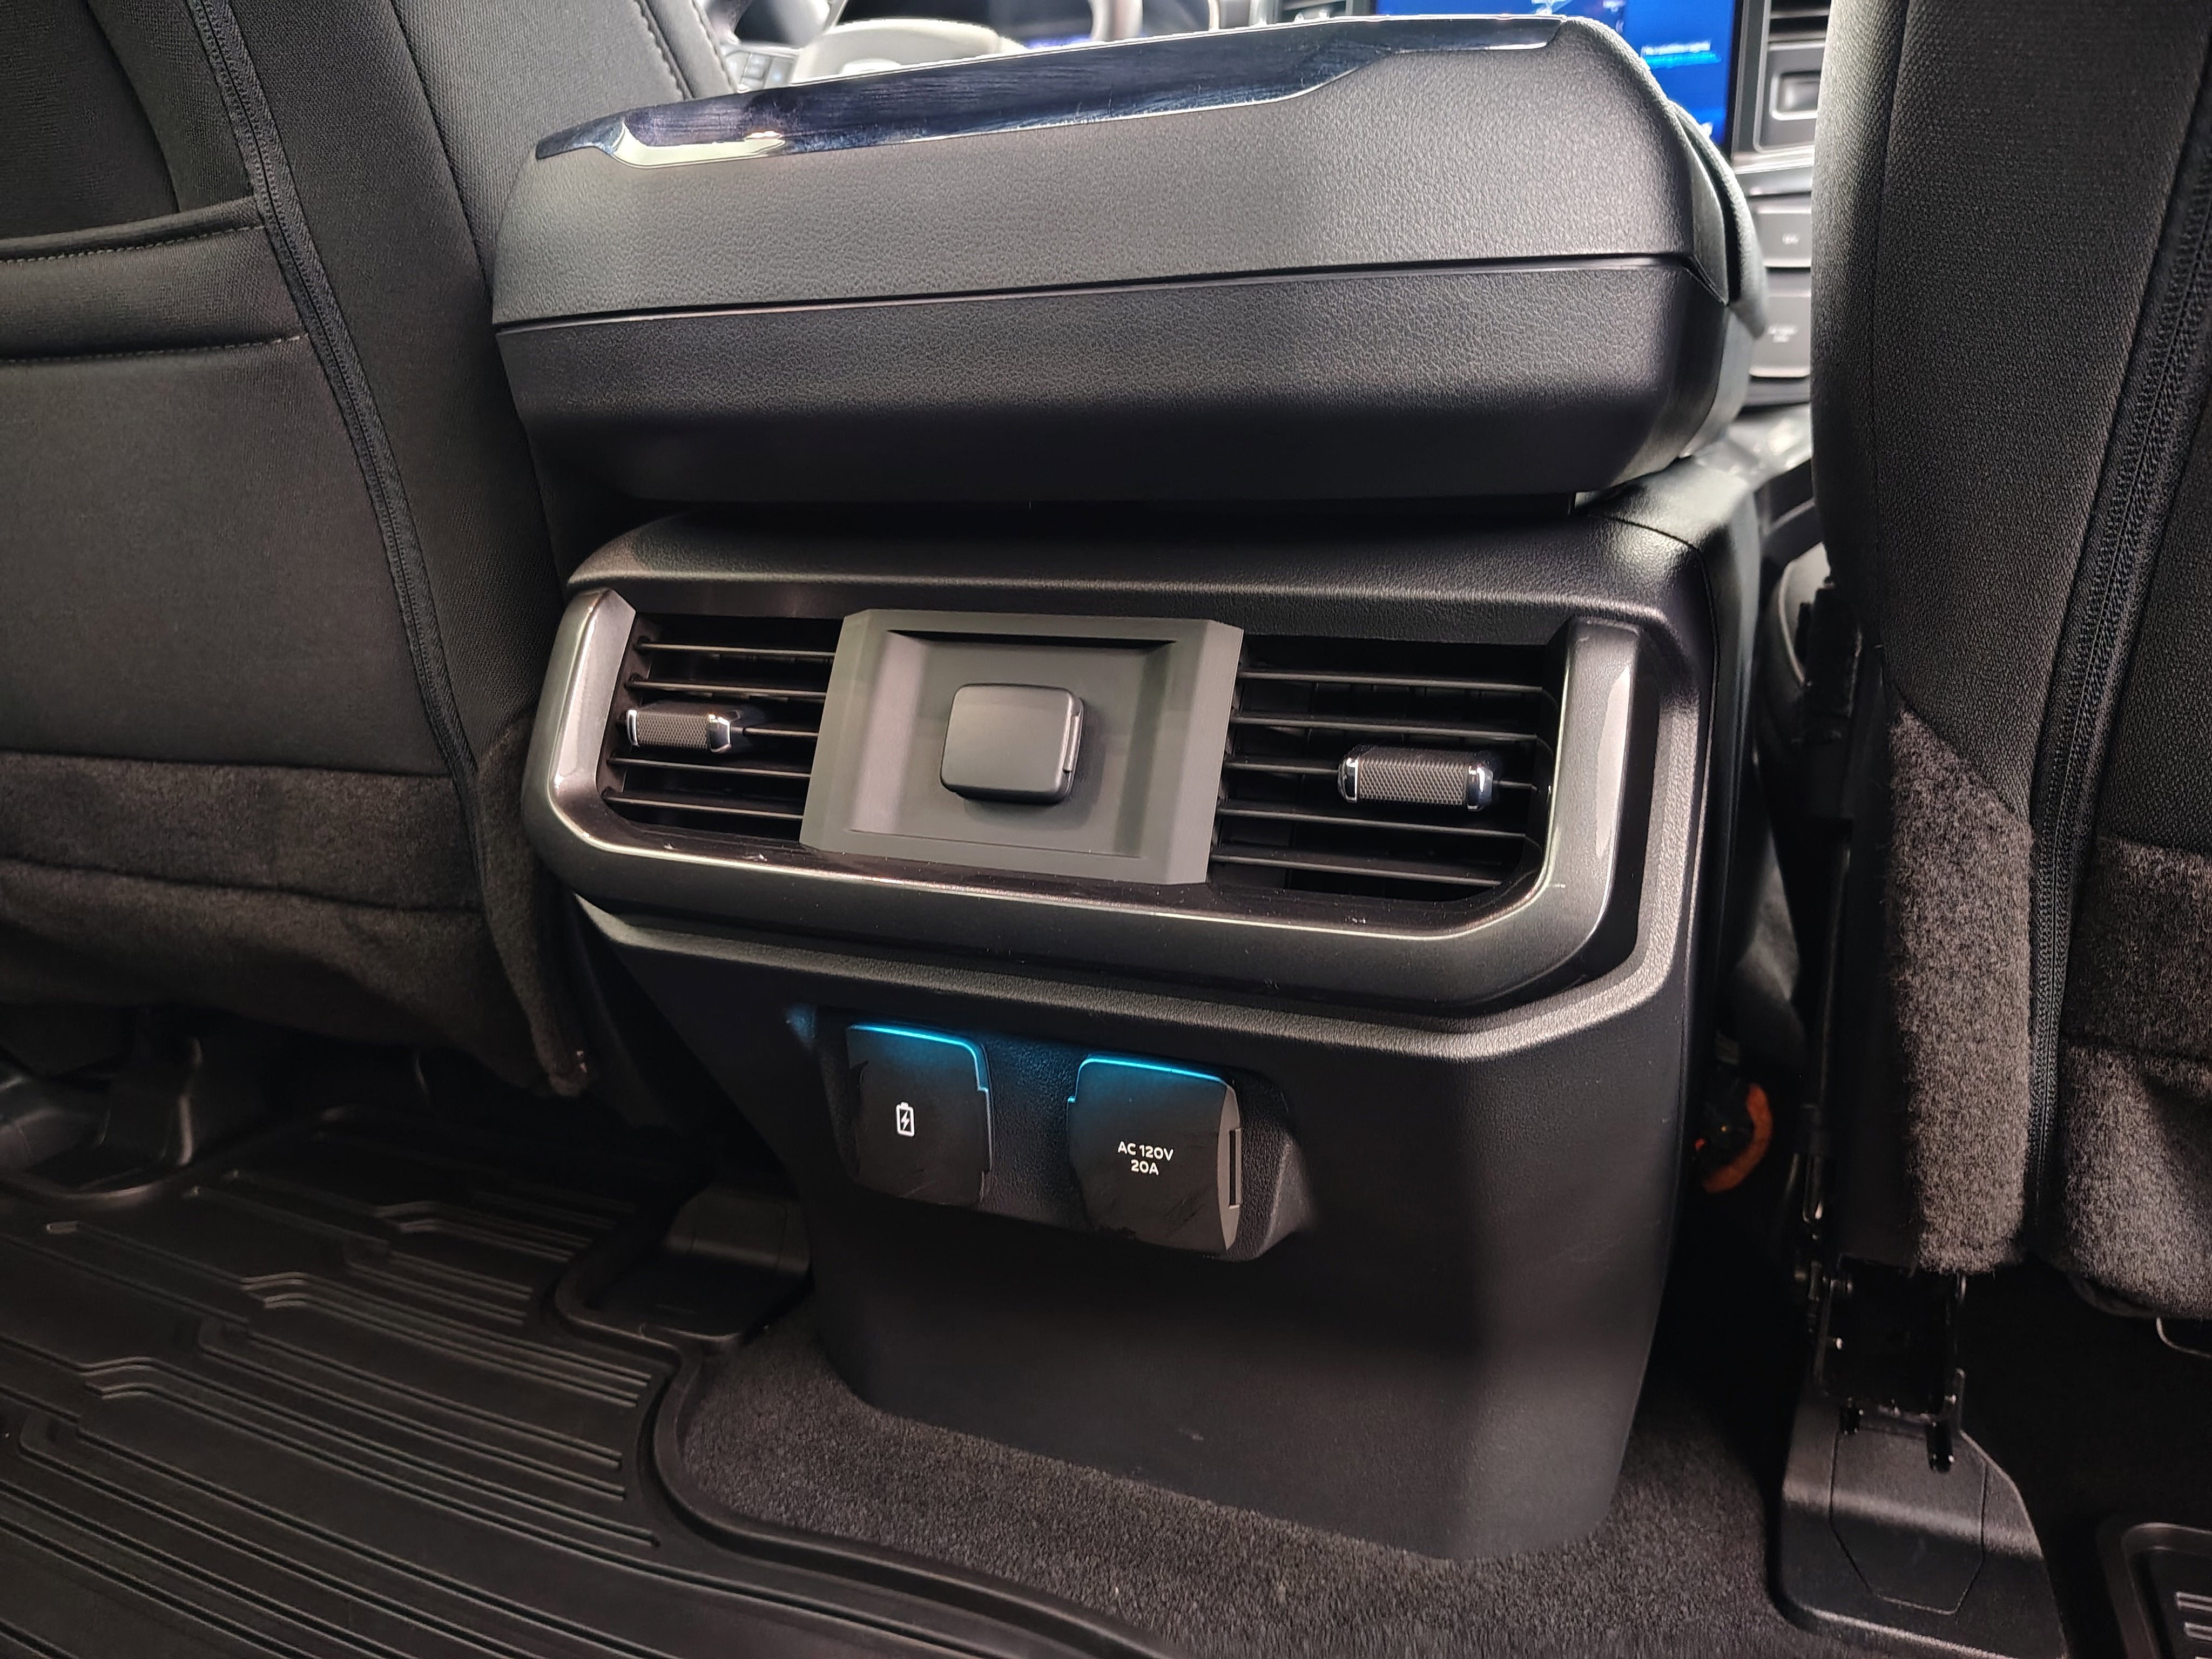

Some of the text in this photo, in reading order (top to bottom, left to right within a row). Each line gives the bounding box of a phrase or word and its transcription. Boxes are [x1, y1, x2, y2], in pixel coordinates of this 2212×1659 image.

[1117, 1141, 1174, 1161] AC 120V
[1131, 1159, 1159, 1175] 20A
